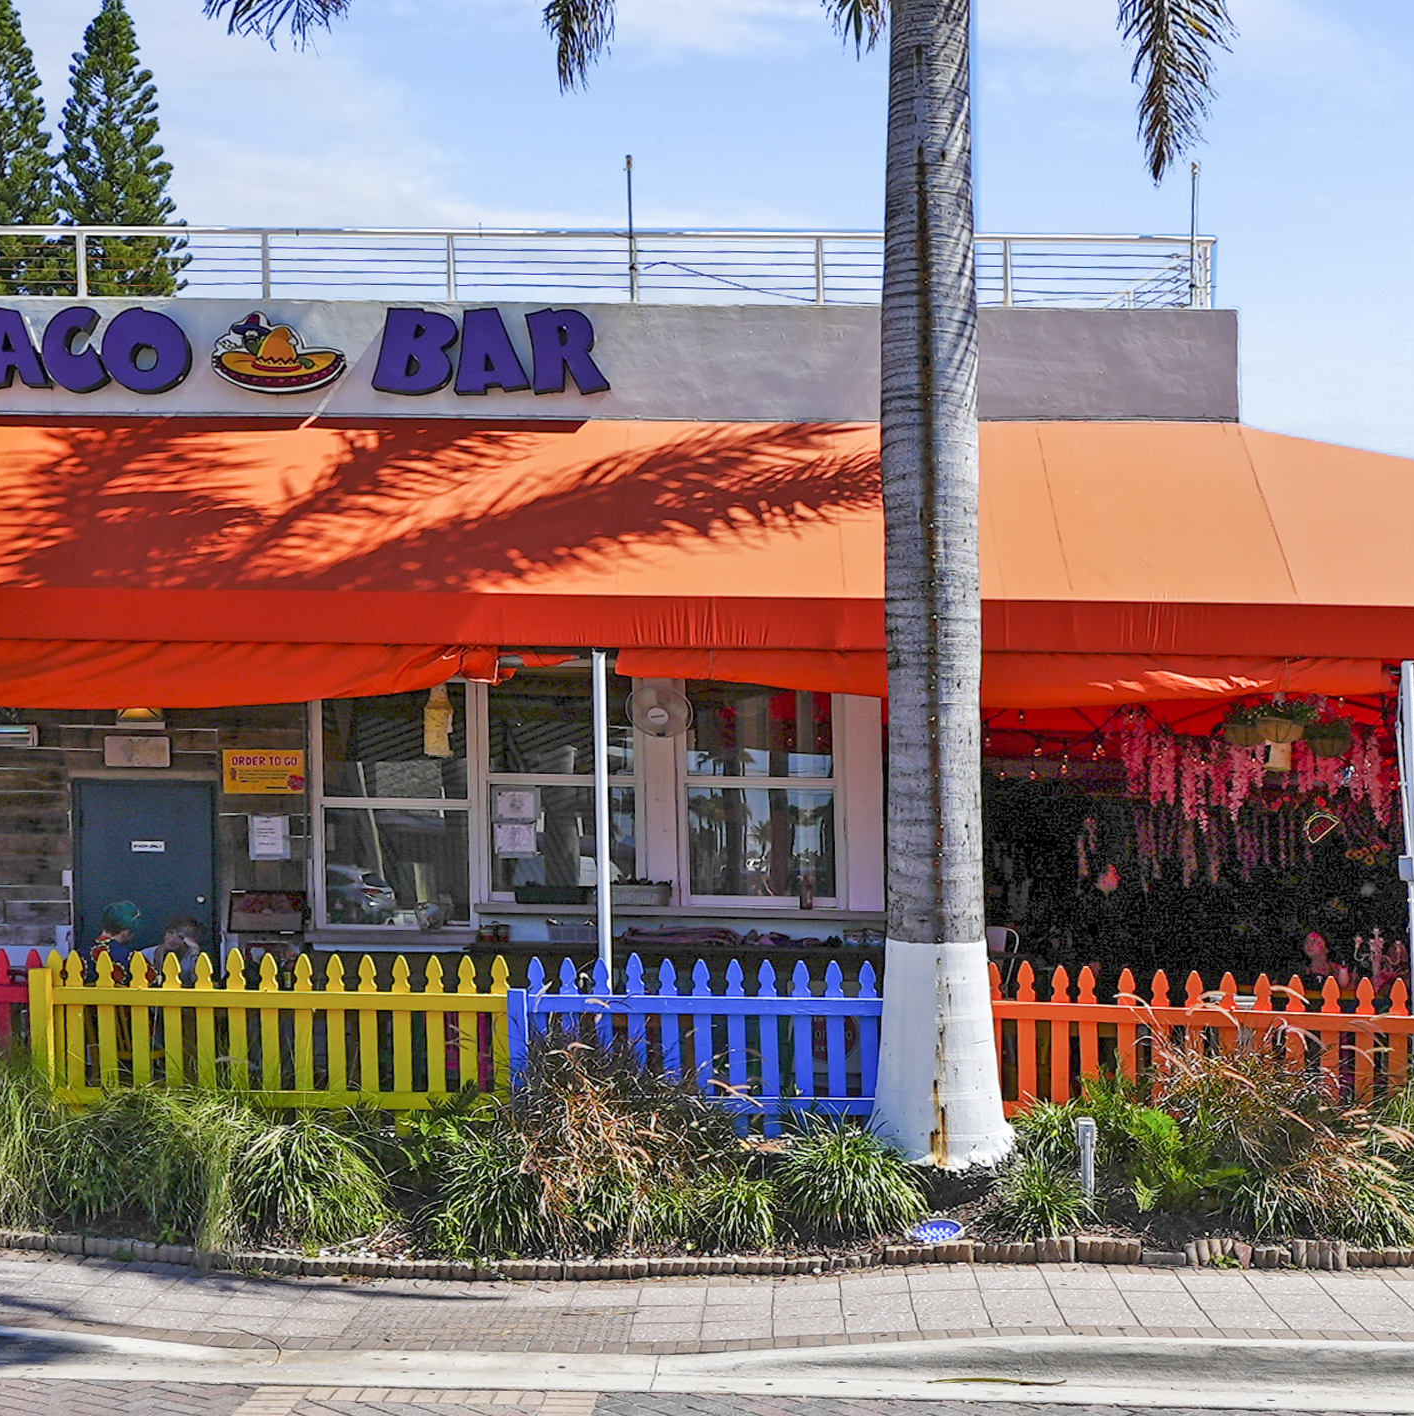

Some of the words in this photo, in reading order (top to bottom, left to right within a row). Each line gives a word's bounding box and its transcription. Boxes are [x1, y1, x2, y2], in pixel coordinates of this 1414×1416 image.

[371, 308, 611, 396] BAR
[232, 756, 265, 766] ORDER
[269, 756, 281, 766] TO
[284, 757, 297, 766] GO
